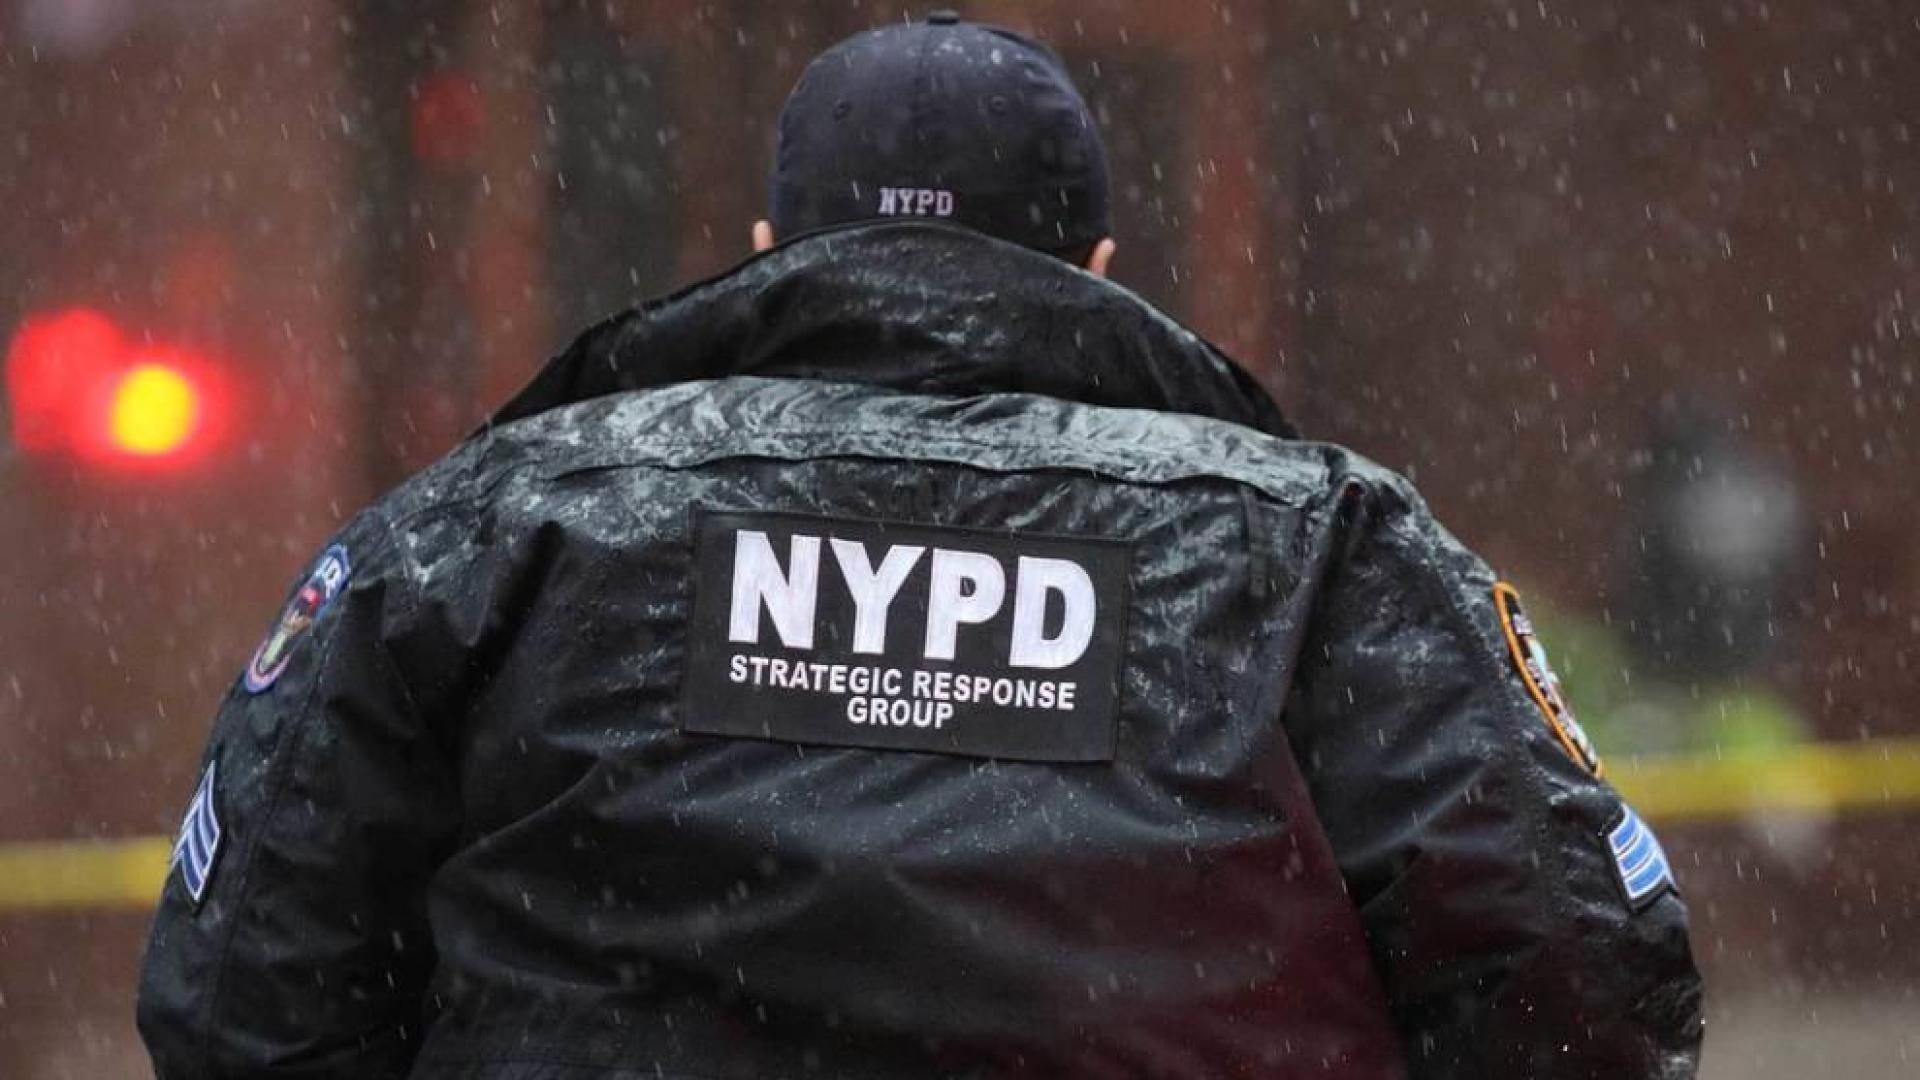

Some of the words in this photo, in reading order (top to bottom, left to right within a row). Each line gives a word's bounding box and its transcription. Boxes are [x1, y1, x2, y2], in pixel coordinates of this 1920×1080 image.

[878, 187, 953, 215] NYPD
[729, 529, 1096, 669] NYPD
[729, 655, 901, 696] STRATEGIC
[913, 670, 1076, 710] RESPONSE
[847, 696, 953, 729] GROUP
